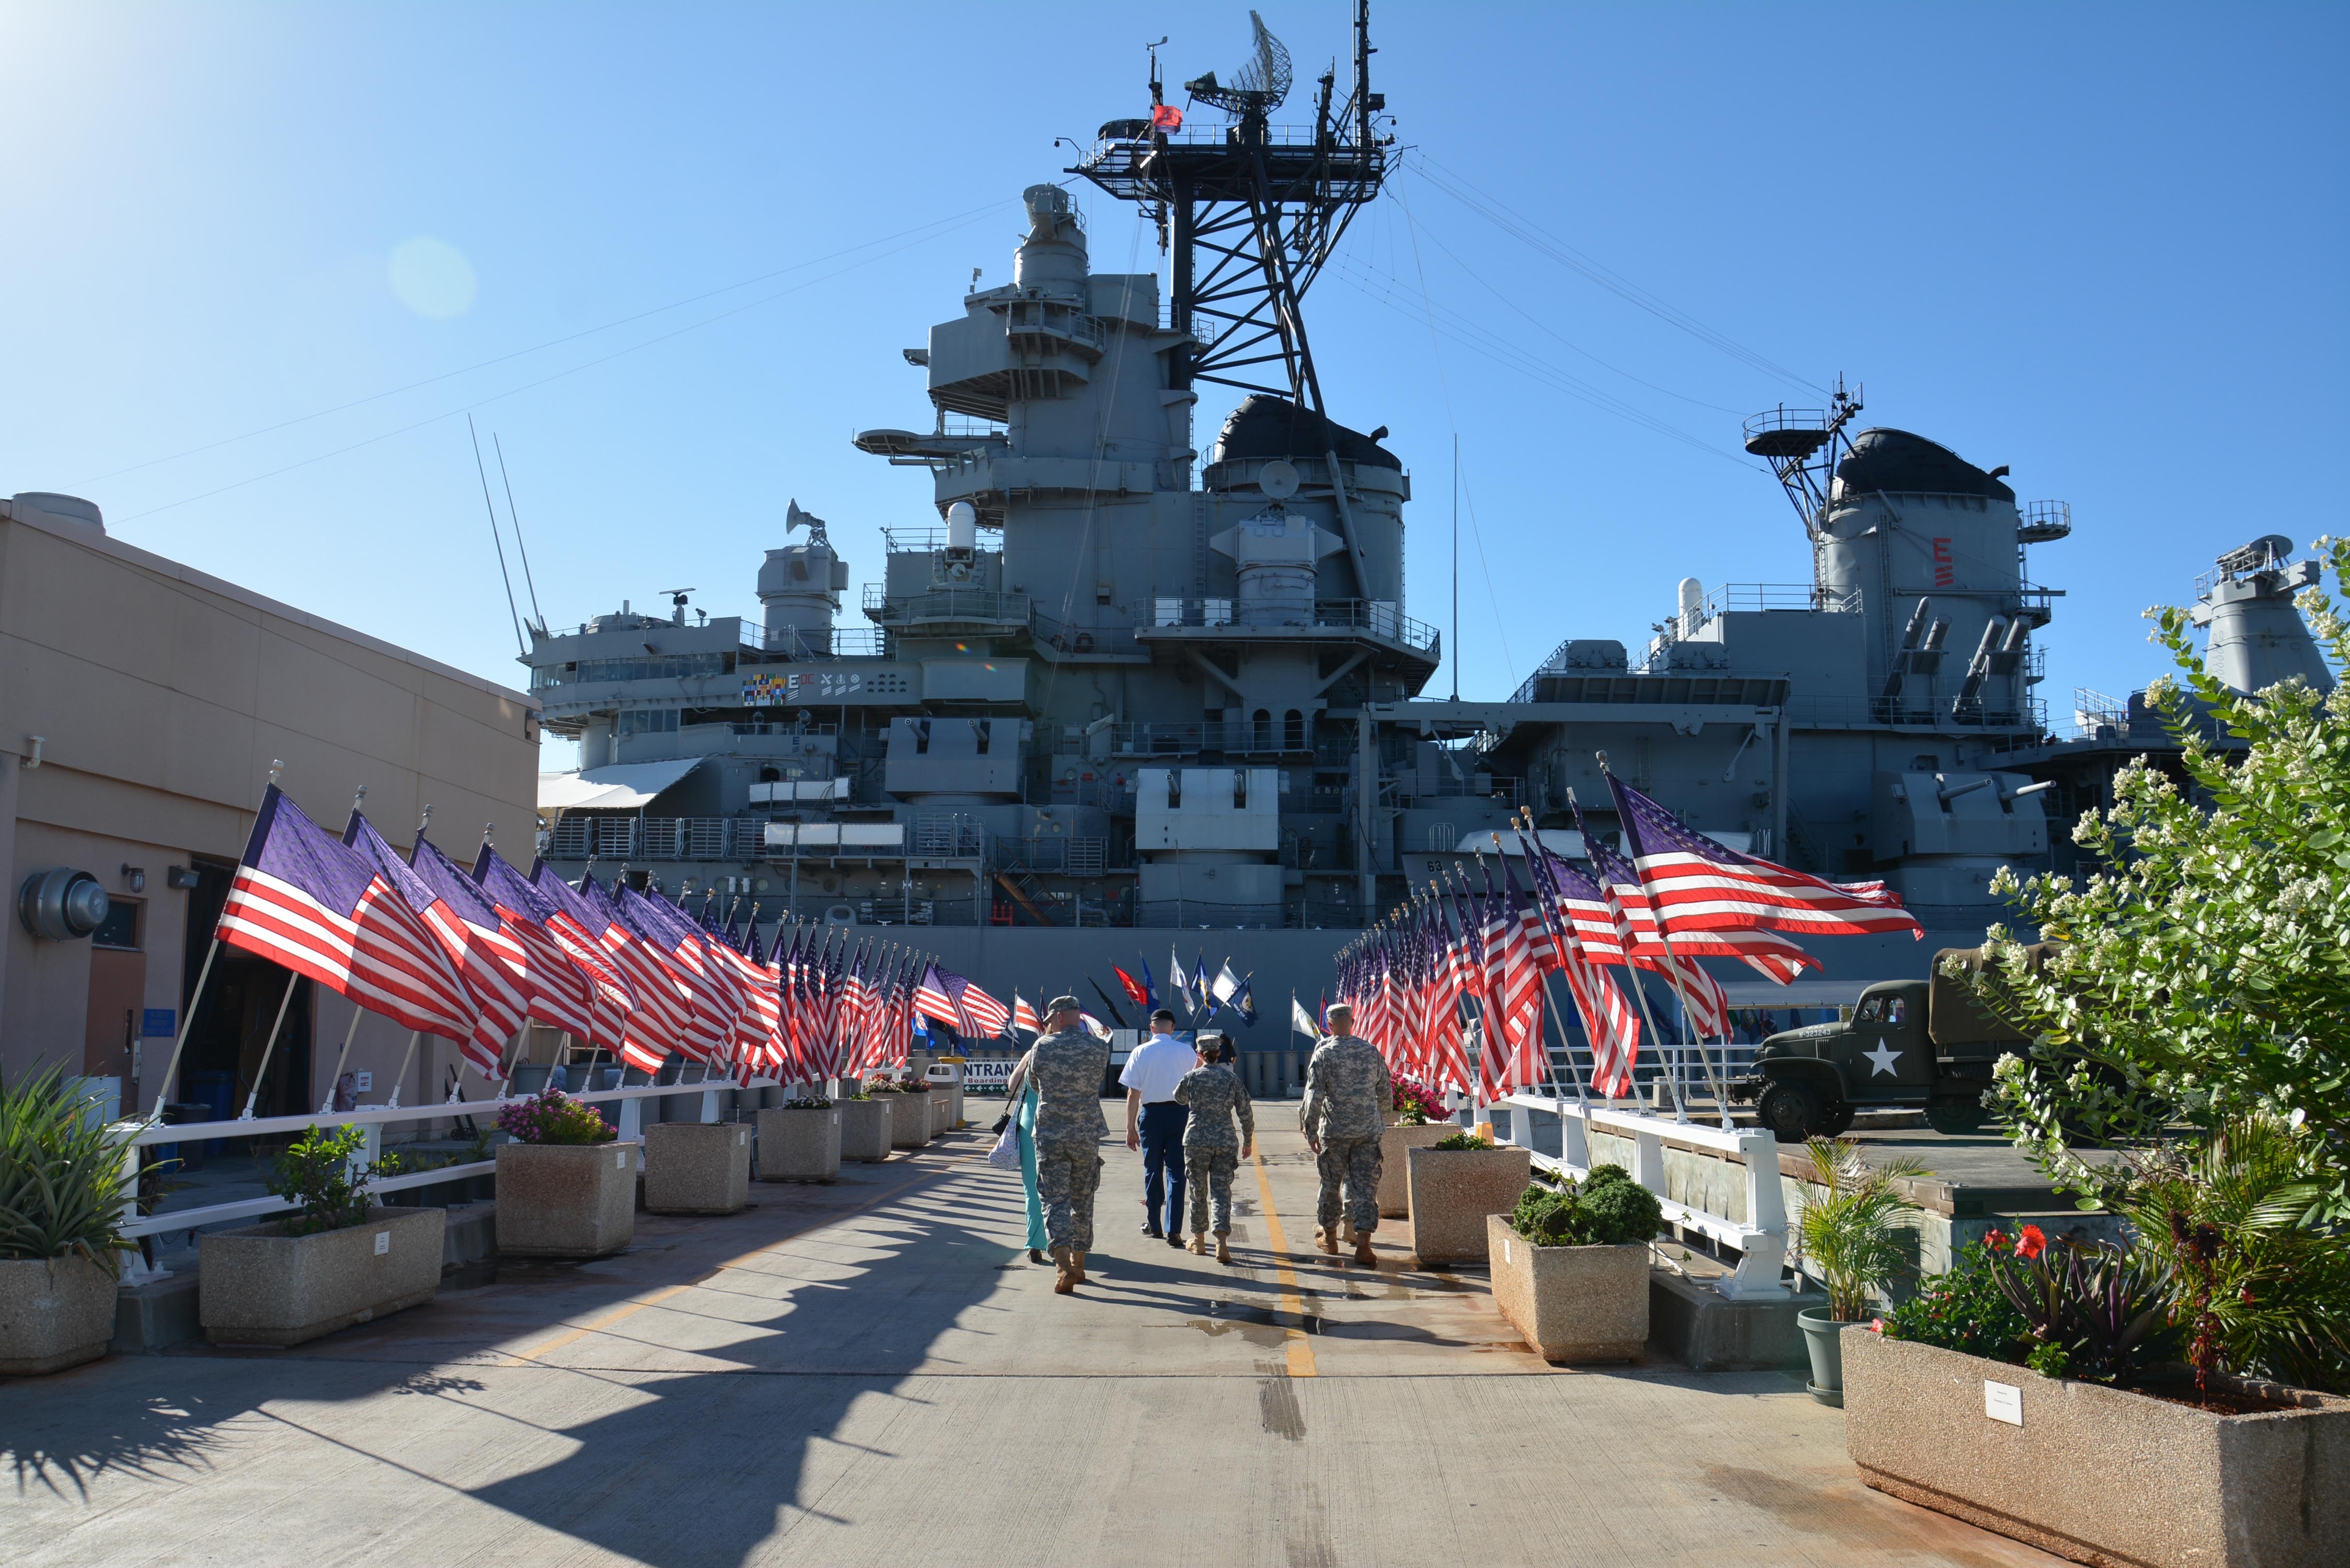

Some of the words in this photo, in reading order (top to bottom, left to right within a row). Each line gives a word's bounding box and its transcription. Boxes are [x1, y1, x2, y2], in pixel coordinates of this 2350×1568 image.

[788, 674, 800, 689] E
[792, 736, 800, 745] E
[1427, 861, 1443, 873] 63
[1799, 1029, 1831, 1038] W-323243
[964, 1063, 1019, 1076] NTRAN
